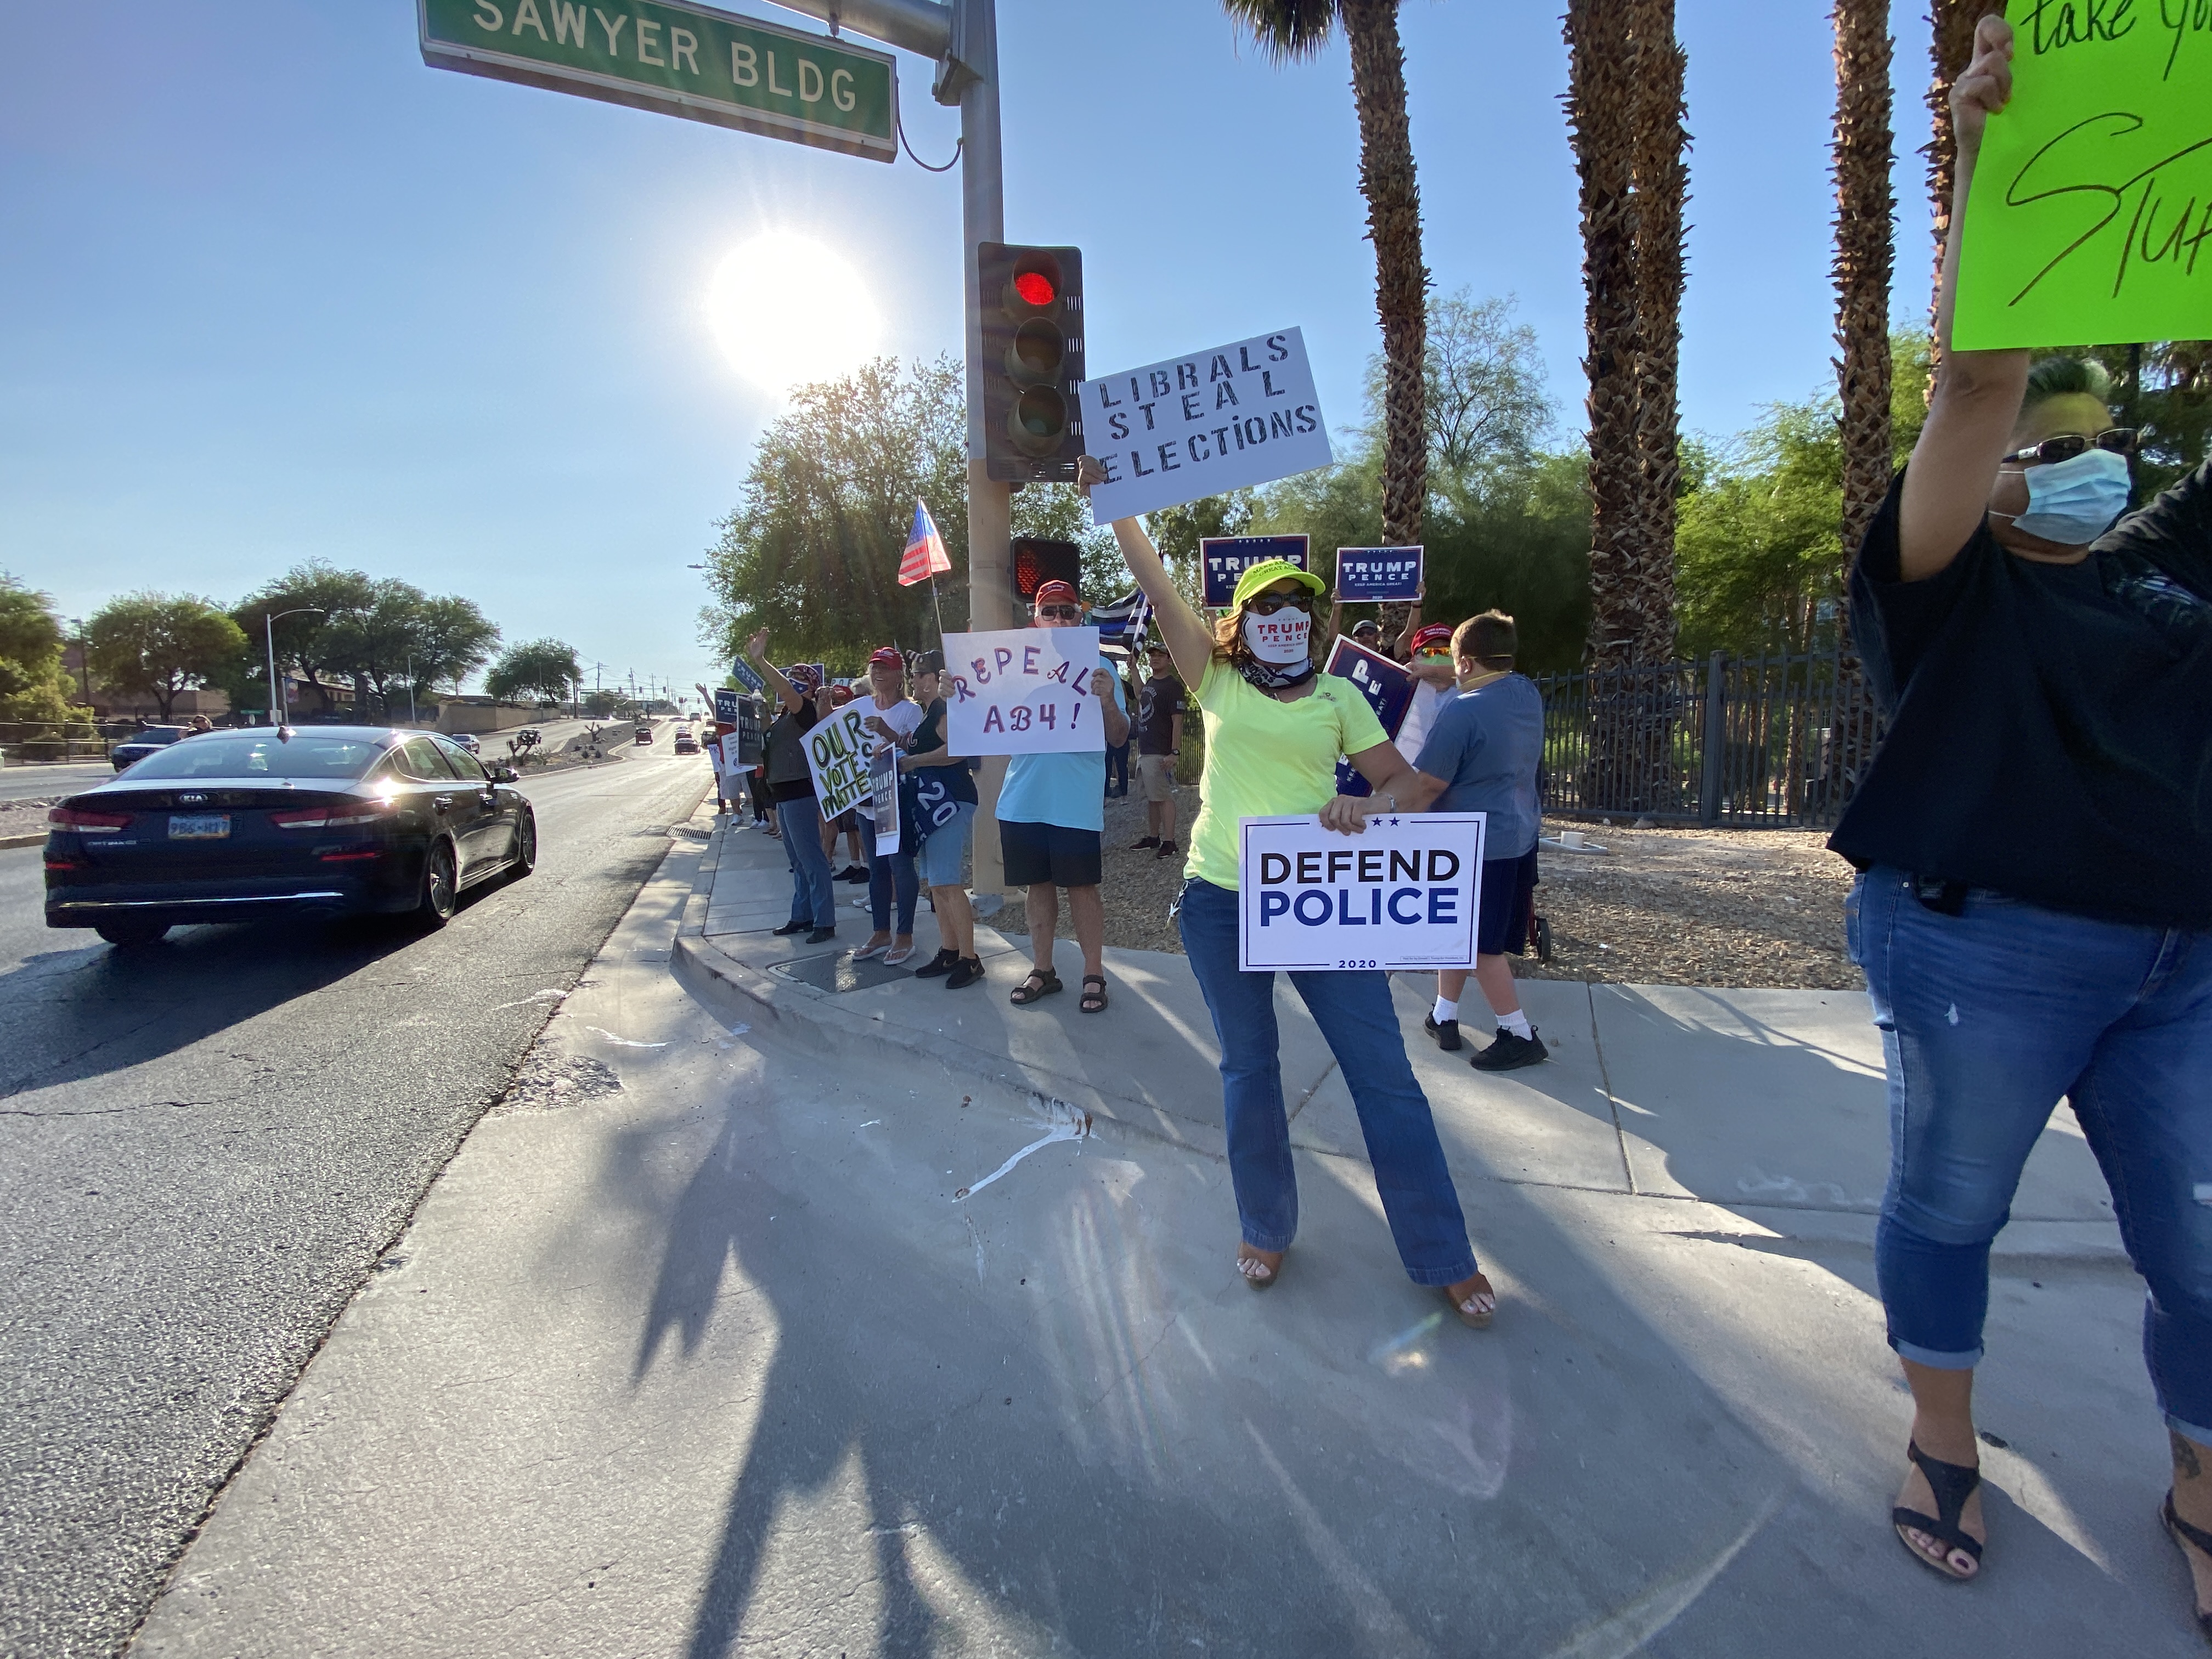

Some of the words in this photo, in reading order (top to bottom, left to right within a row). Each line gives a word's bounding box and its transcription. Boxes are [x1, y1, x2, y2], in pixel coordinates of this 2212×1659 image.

[473, 0, 699, 76] SAWYER
[731, 41, 856, 112] BLDG
[2160, 0, 2212, 82] yo
[1099, 335, 1289, 408] LIBRALS
[1109, 371, 1285, 439] STEAL
[1342, 561, 1417, 573] TRUMP
[1348, 573, 1409, 581] PENCE
[1257, 620, 1309, 634] TRUMP
[1262, 633, 1307, 642] PENCE
[951, 645, 1089, 703] REPEAL
[717, 699, 737, 708] TRU
[812, 709, 874, 770] OUR
[821, 774, 872, 820] MATTE
[1261, 849, 1460, 885] DEFEND
[1260, 887, 1459, 927] POLICE
[1338, 960, 1377, 969] 2020
